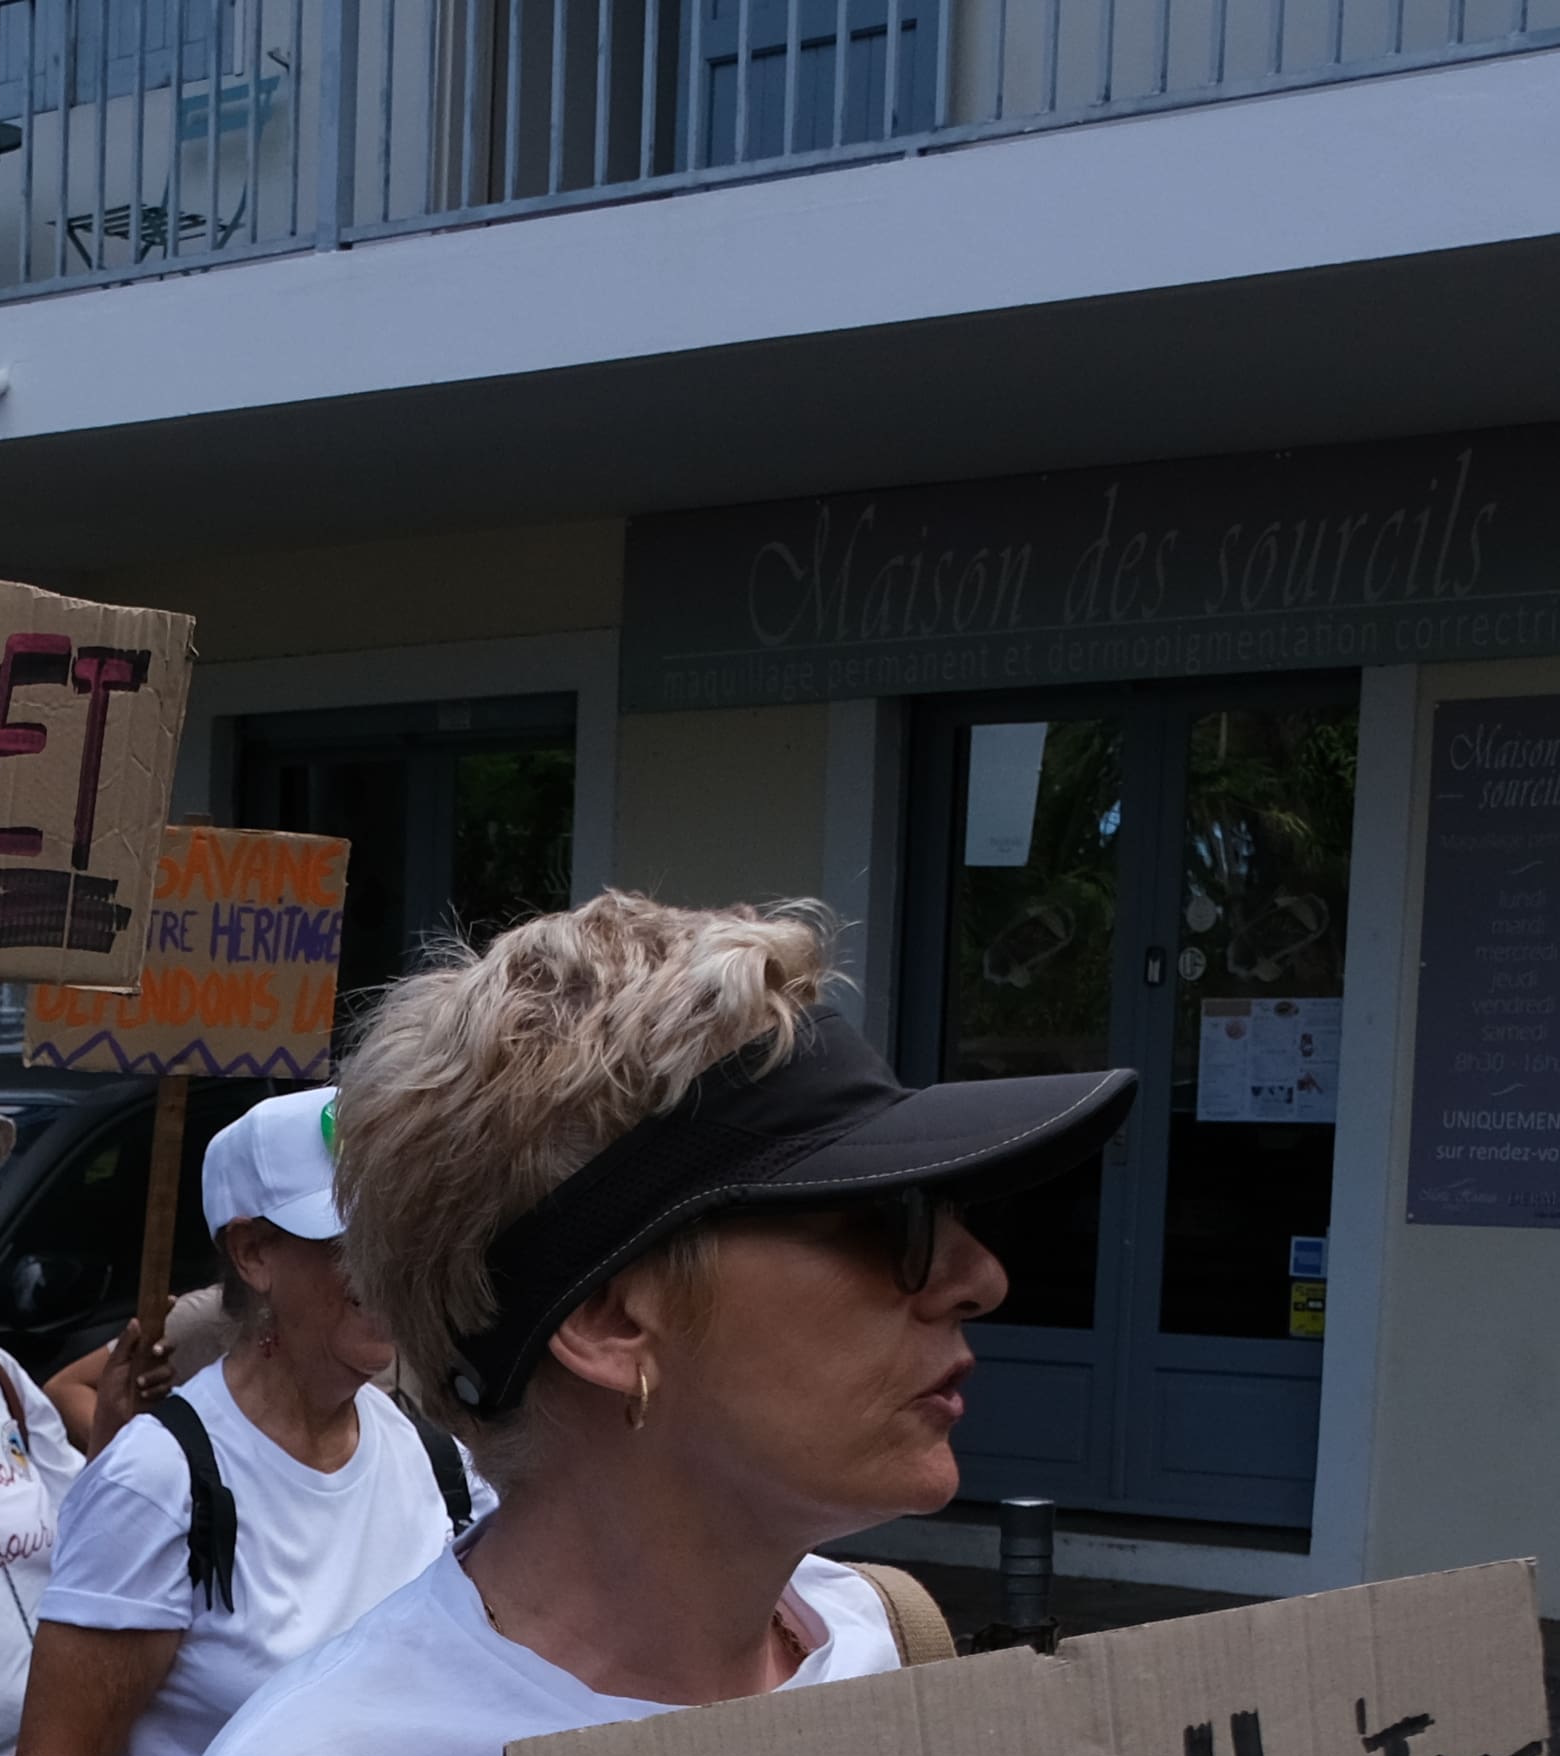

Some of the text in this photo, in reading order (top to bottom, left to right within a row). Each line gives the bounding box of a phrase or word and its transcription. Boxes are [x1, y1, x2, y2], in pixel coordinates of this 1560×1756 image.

[747, 447, 1500, 649] Maison des sourcils
[662, 657, 816, 709] maquillage
[826, 639, 991, 694] permanent
[1003, 643, 1033, 681] et
[1046, 612, 1379, 678] dermopigmentation
[152, 826, 346, 908] SAVANE
[1498, 888, 1547, 909] lundi
[1490, 916, 1546, 936] mardi
[1474, 942, 1559, 962] mercredi
[1488, 969, 1539, 994] jeudi
[1471, 995, 1556, 1016] vendredi
[1480, 1022, 1548, 1042] samedi
[1435, 1143, 1463, 1161] sur
